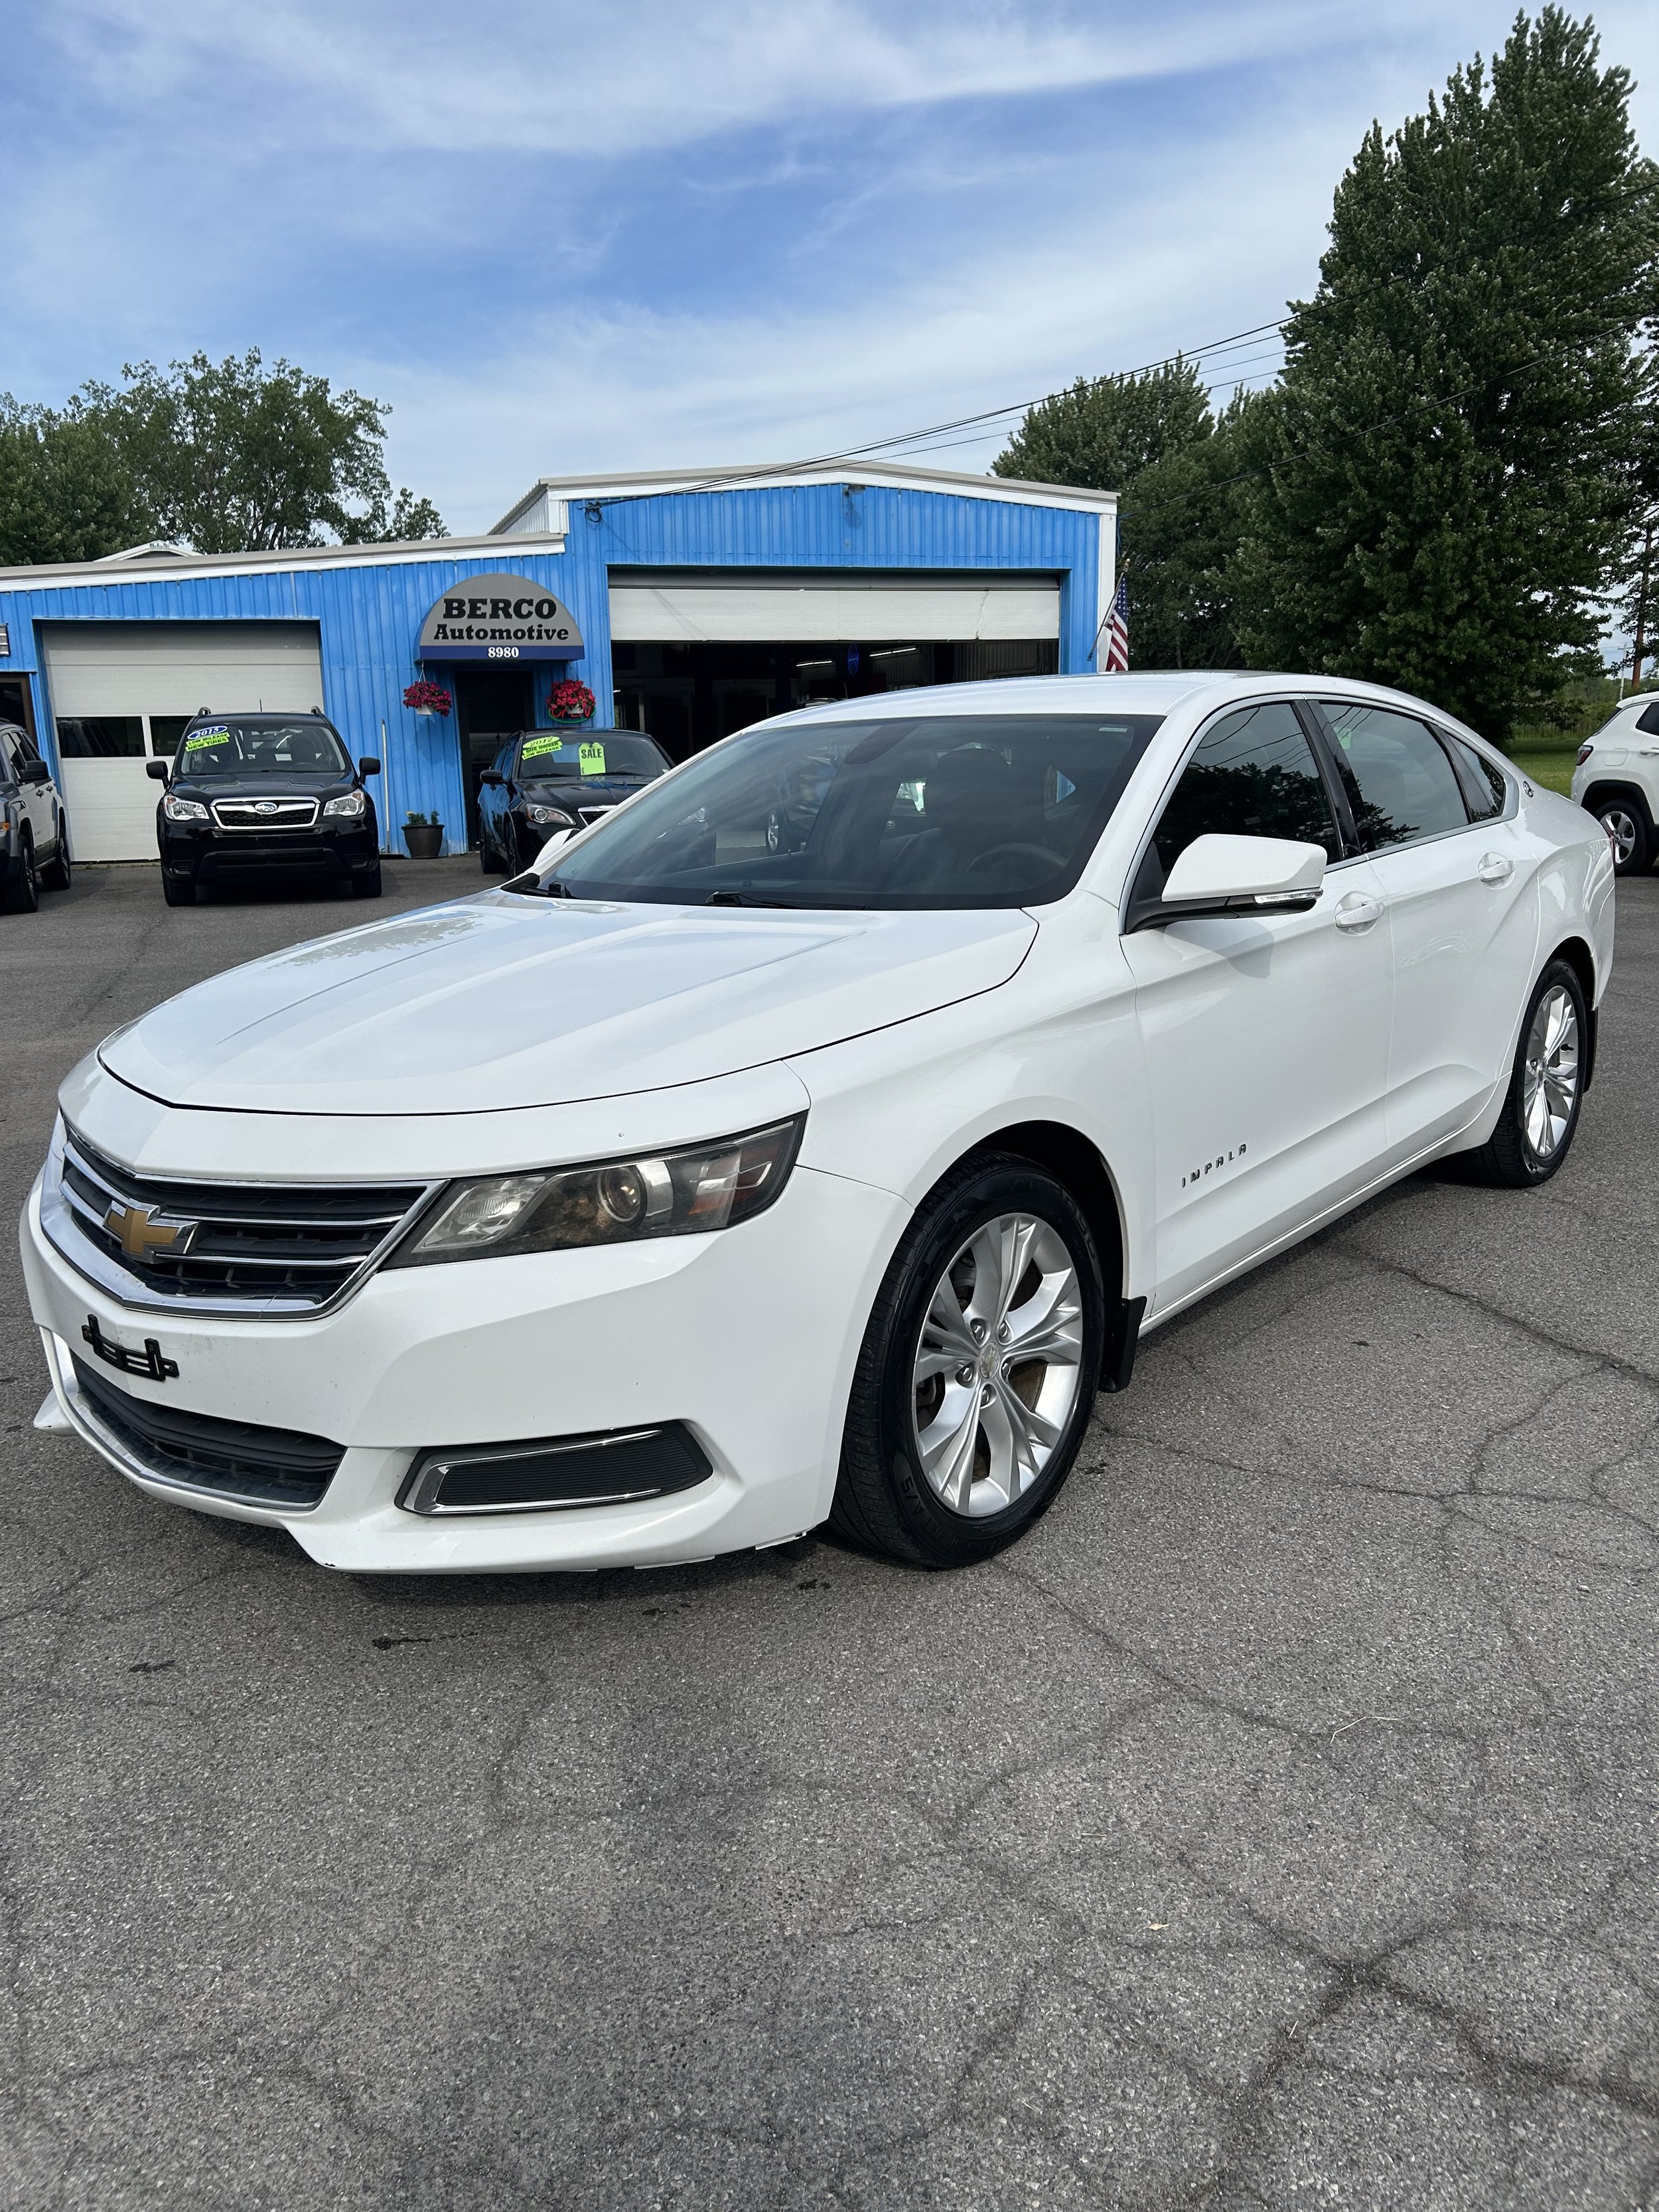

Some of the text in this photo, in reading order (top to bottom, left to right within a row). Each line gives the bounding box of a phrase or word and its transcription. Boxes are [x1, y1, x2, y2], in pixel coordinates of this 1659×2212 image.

[443, 598, 557, 619] BERCO
[433, 624, 569, 640] Automotive
[488, 646, 519, 658] 8980
[196, 727, 219, 737] 2015
[530, 737, 553, 747] 2012
[581, 748, 603, 759] SALE
[1181, 1143, 1246, 1188] IMPALA
